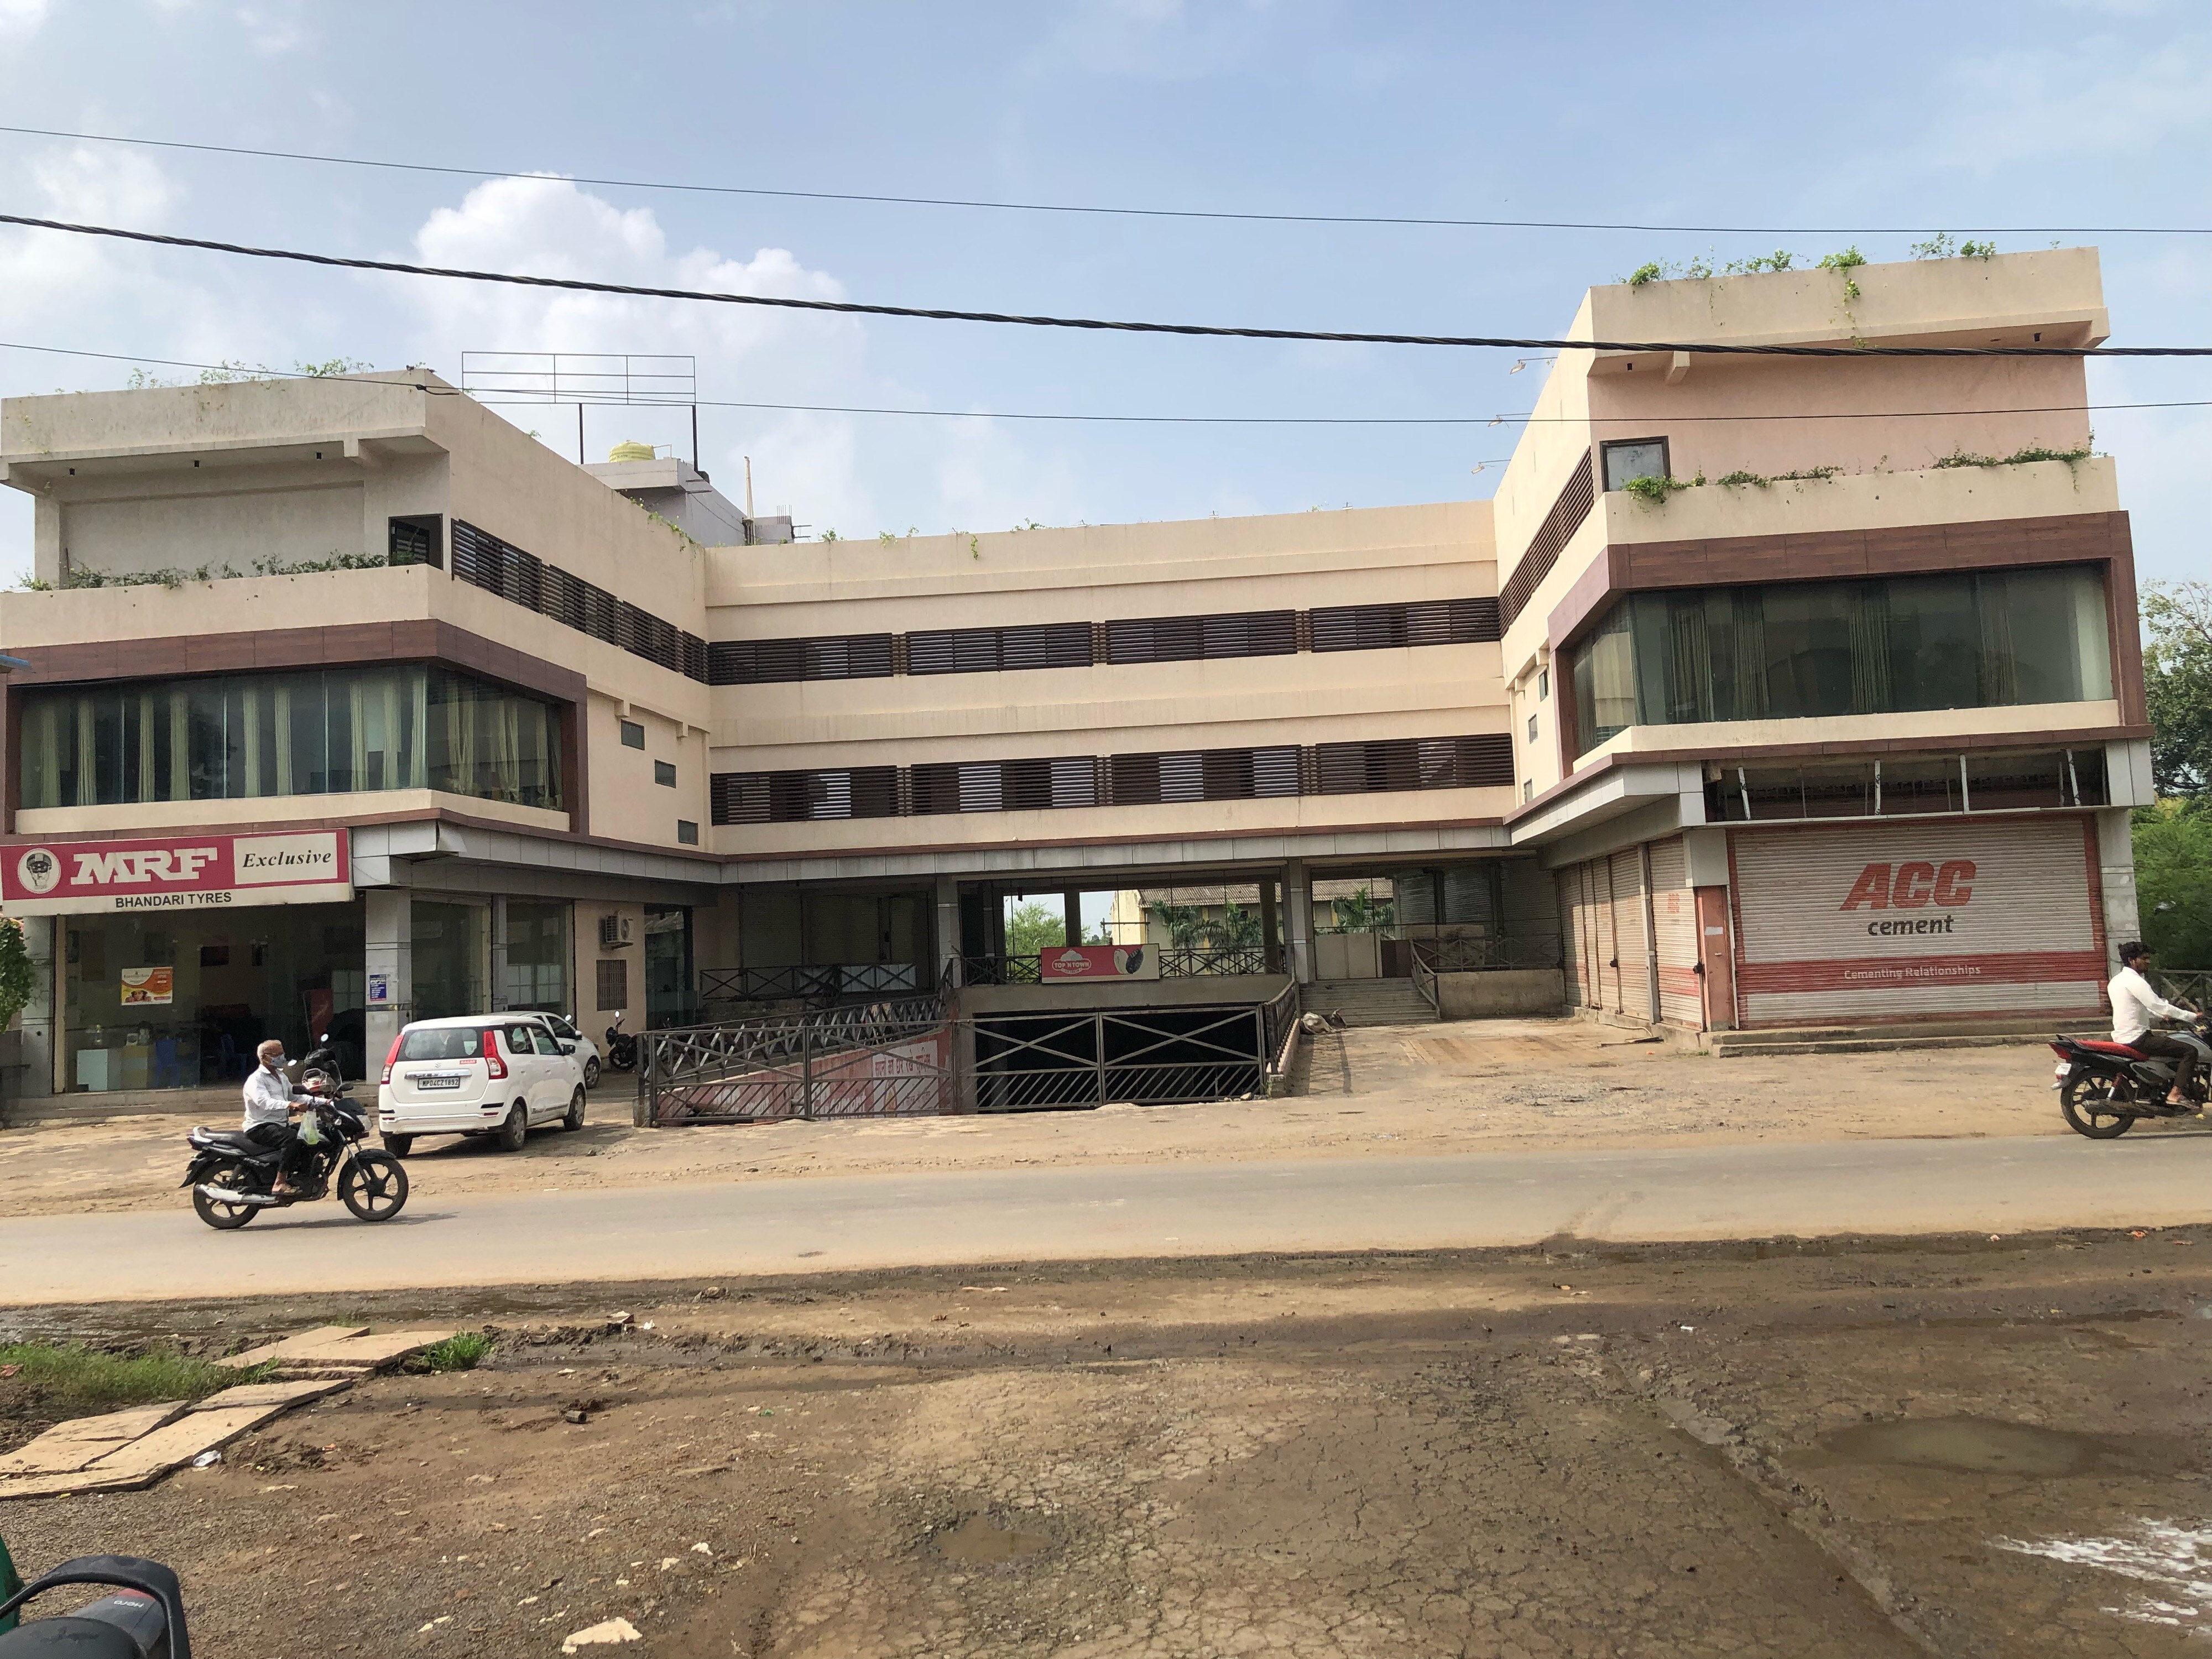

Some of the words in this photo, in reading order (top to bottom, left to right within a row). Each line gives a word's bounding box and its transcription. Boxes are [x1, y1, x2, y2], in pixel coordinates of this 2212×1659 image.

[71, 847, 217, 885] MRF
[242, 849, 331, 868] Exclusive
[1838, 860, 1976, 911] ACC
[116, 894, 184, 908] BHANDARI
[187, 892, 232, 904] TYRES
[1867, 915, 1954, 936] cement
[1844, 968, 1903, 980] Cementing
[1905, 964, 1981, 978] Relationships
